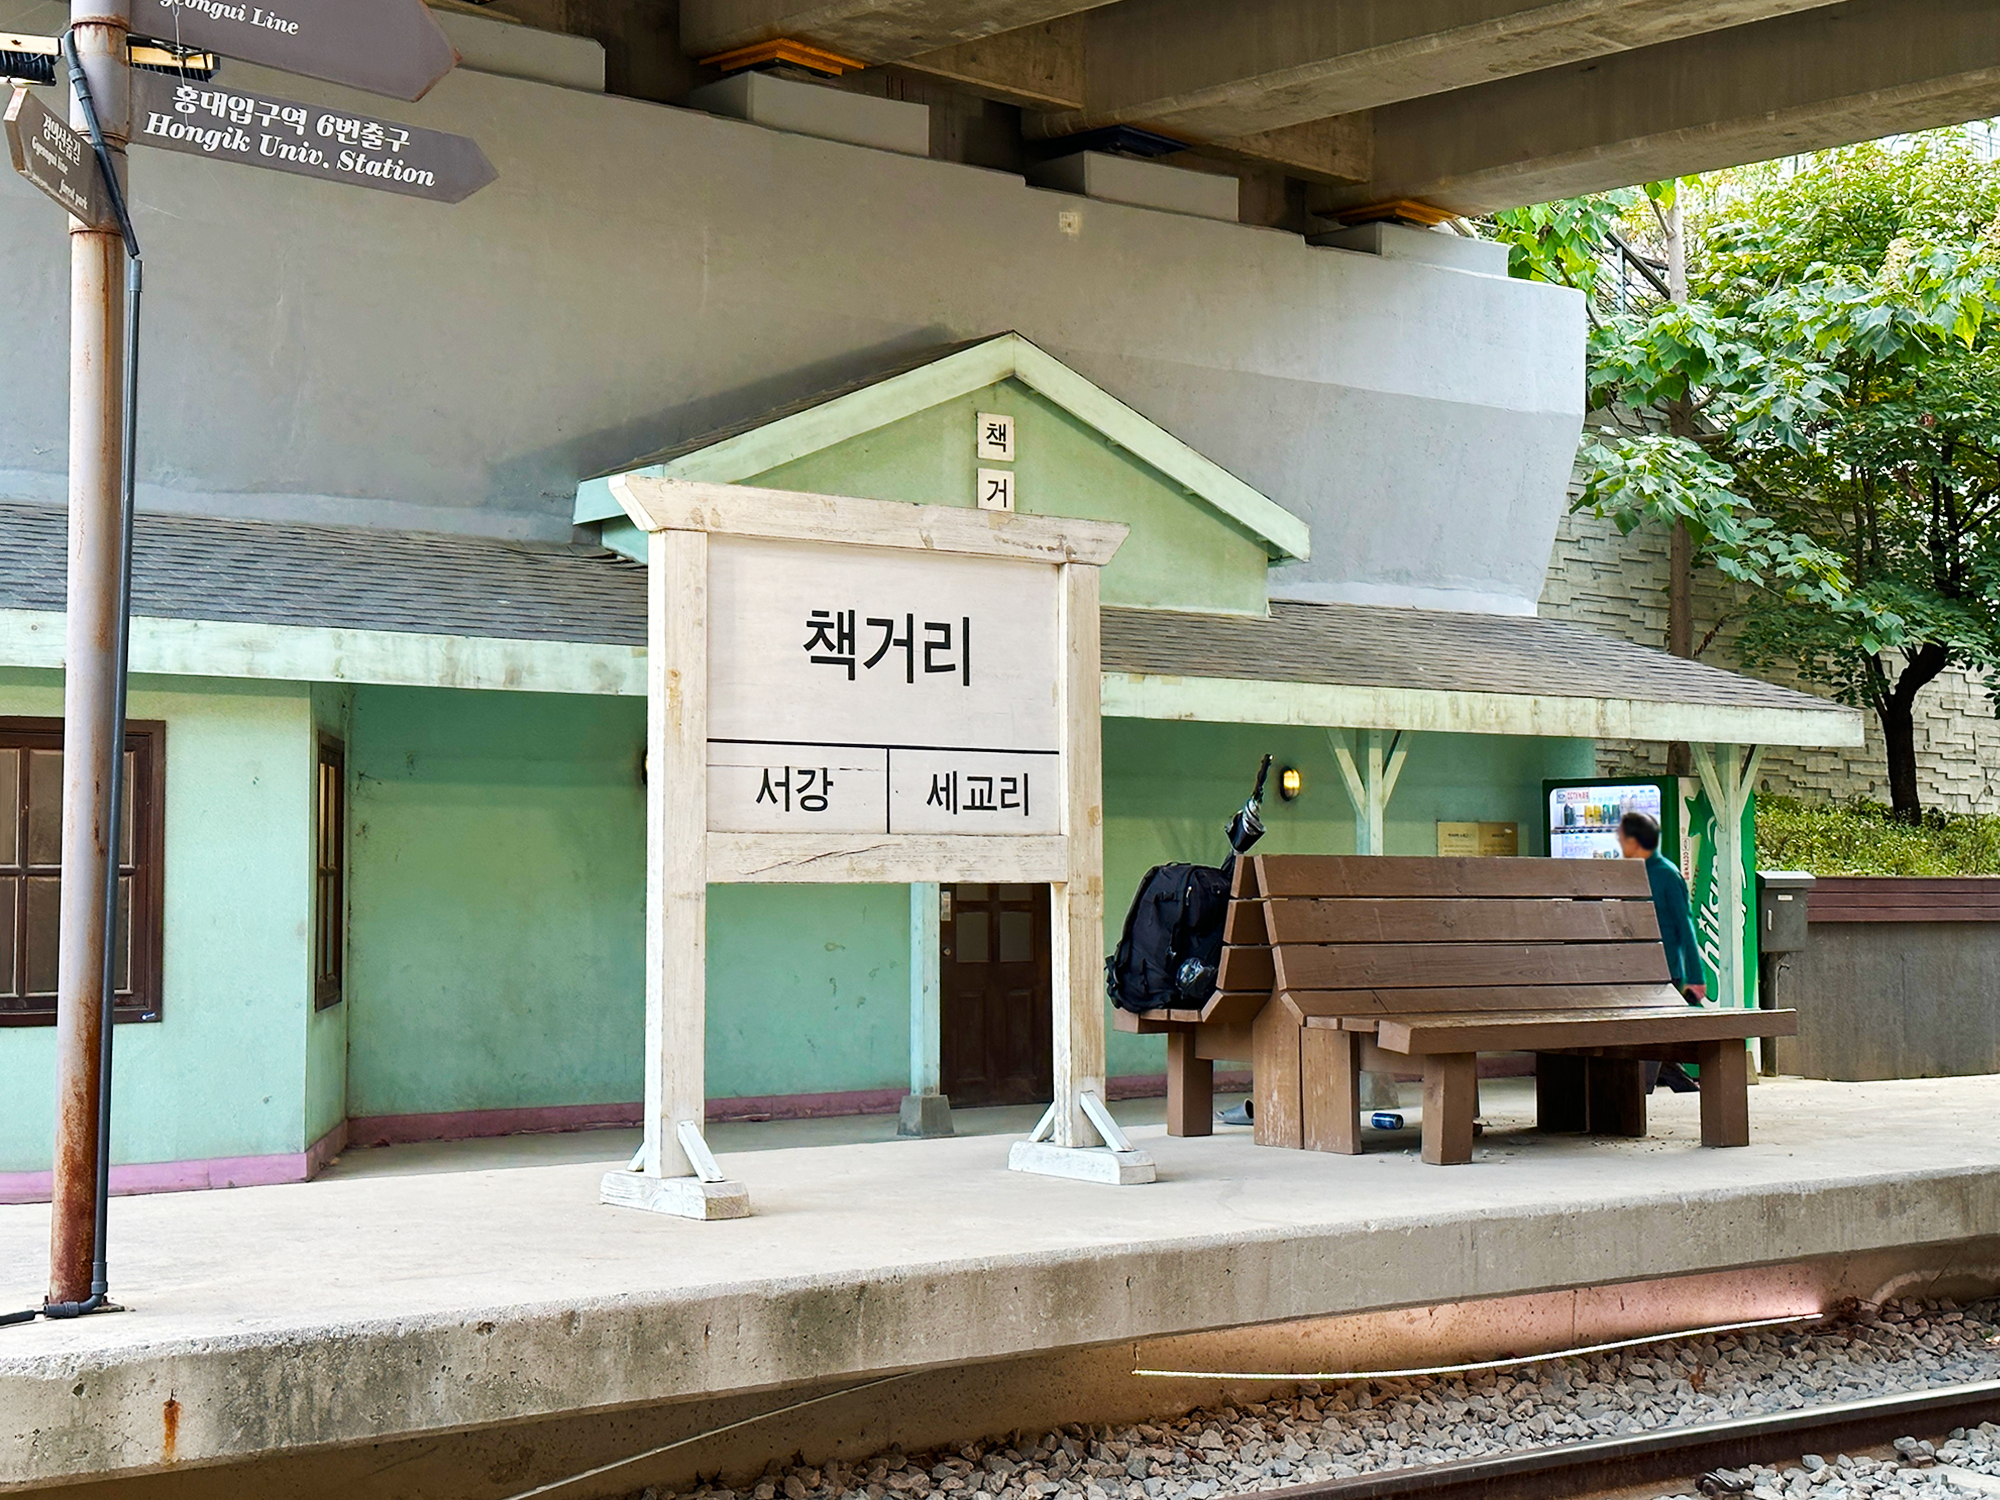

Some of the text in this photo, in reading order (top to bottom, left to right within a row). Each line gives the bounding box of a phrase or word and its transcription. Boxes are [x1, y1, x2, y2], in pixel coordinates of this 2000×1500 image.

[250, 8, 299, 35] Line
[172, 85, 410, 152] 홍대입구역 6번출구
[144, 112, 434, 186] Hongik Univ. Station
[803, 608, 970, 686] 책거리
[756, 766, 834, 812] 서강
[926, 770, 1029, 816] 세교리
